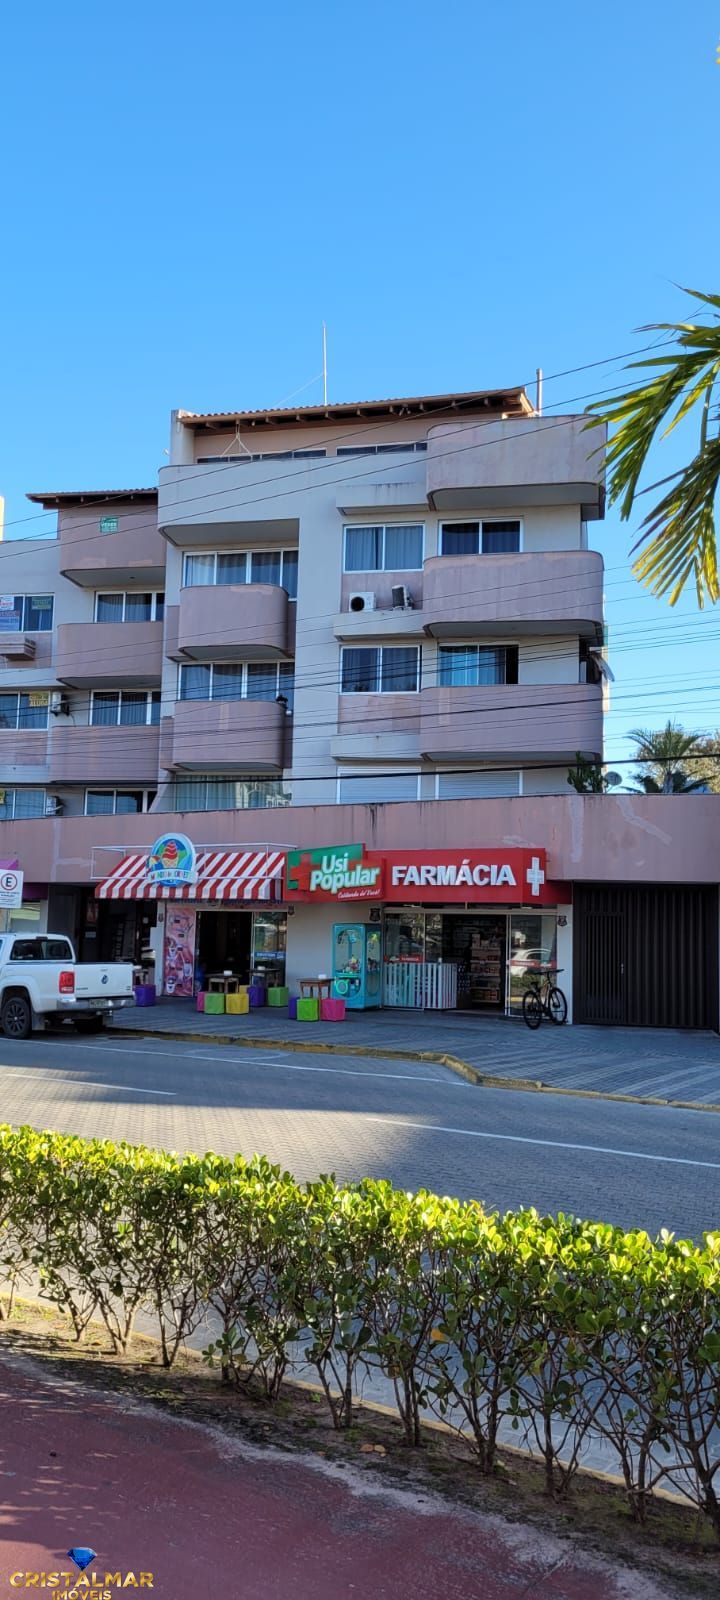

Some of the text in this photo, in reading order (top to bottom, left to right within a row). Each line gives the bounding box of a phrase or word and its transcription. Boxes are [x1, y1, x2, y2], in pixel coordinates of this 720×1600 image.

[322, 853, 348, 873] Usi
[392, 859, 517, 885] FARMÁCIA
[5, 876, 13, 887] E
[310, 865, 380, 894] Popular
